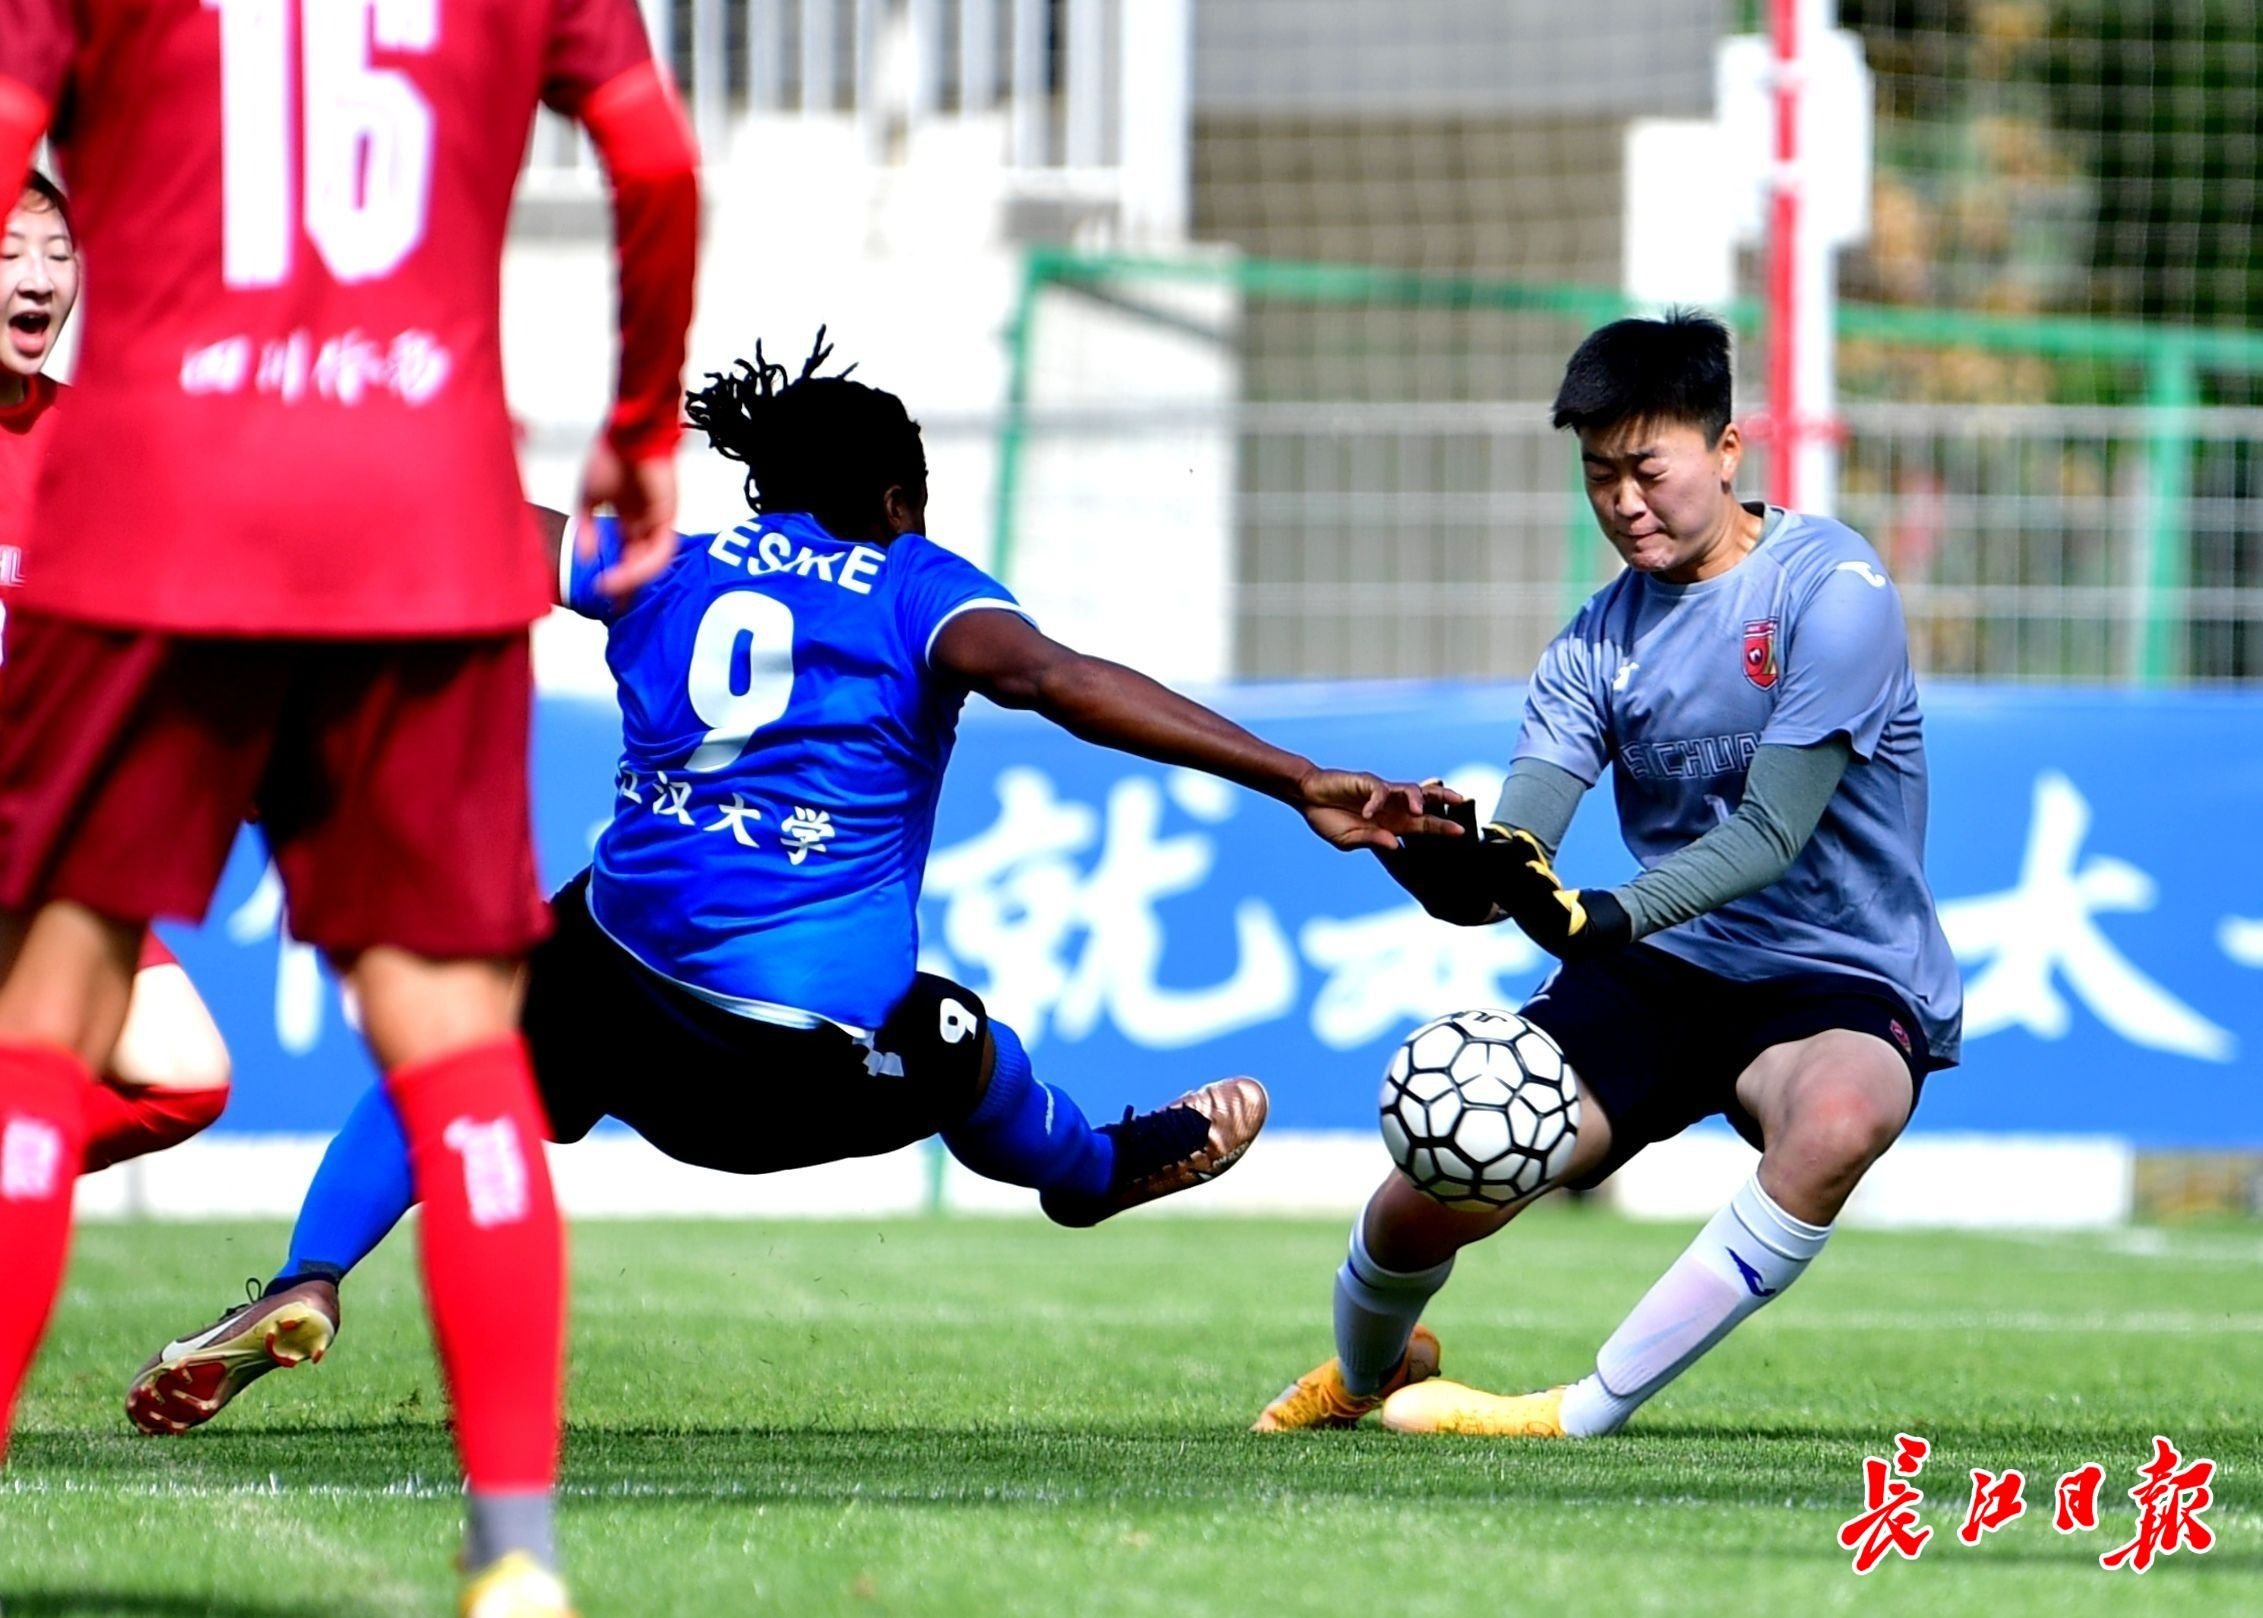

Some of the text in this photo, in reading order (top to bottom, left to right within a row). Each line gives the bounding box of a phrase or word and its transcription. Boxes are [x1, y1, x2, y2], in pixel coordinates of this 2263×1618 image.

[214, 0, 441, 290] 16
[685, 590, 795, 773] 9
[1619, 732, 1762, 780] SICHUA
[939, 997, 978, 1044] 9
